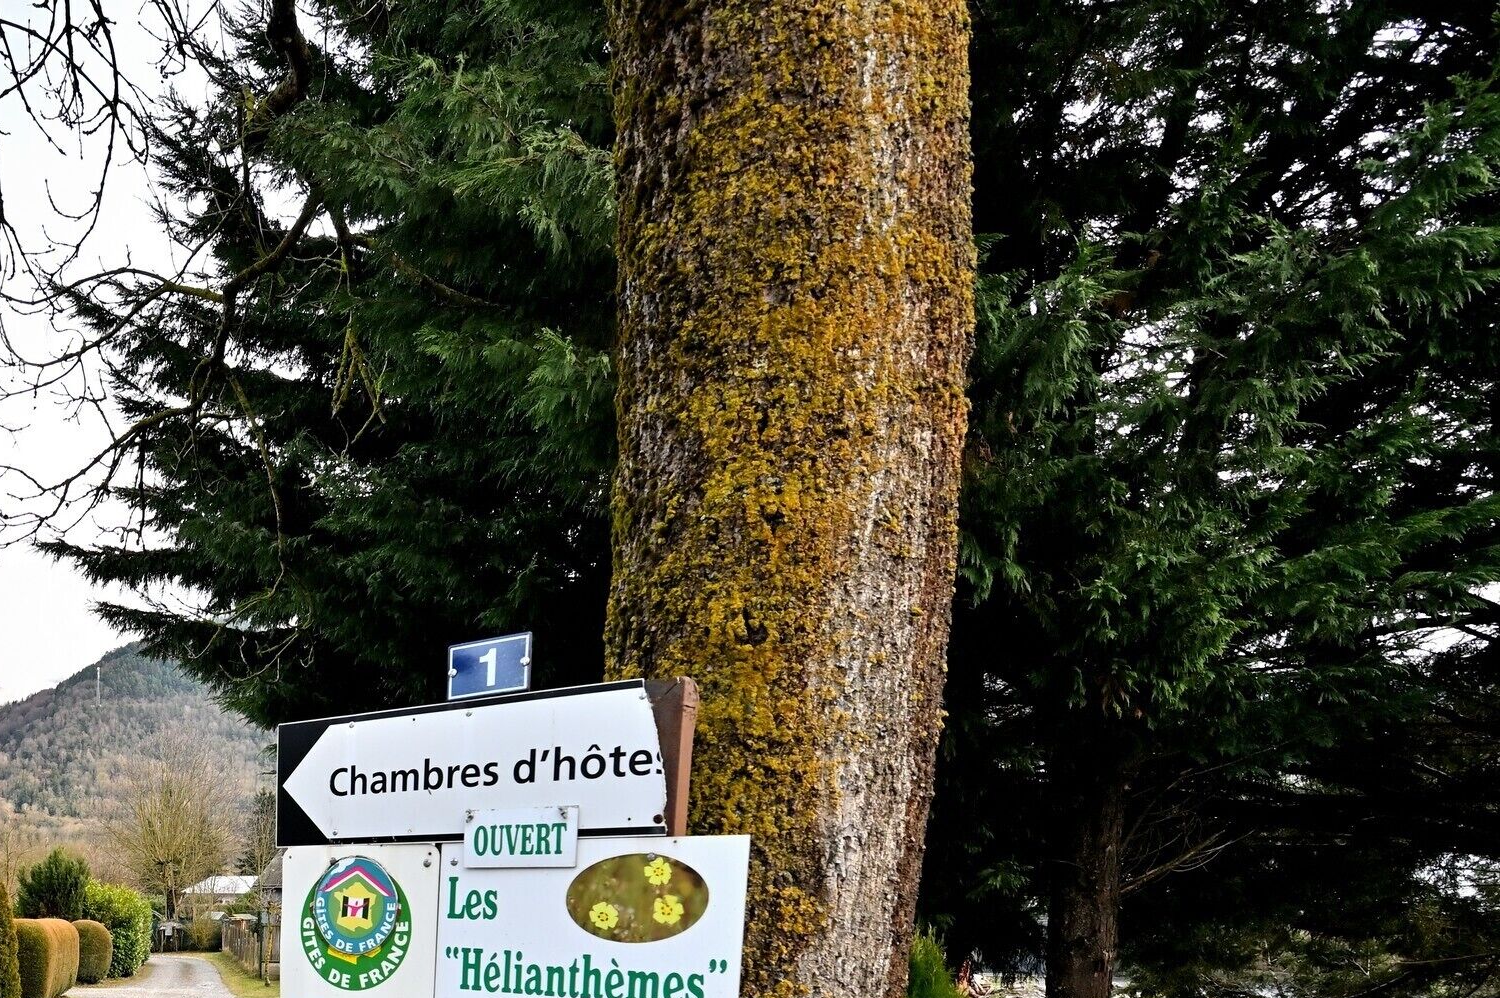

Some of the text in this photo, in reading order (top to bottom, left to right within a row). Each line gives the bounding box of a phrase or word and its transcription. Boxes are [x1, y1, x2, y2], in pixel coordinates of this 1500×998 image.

[479, 648, 497, 687] 1
[328, 758, 499, 797] Chambres
[473, 822, 568, 857] OUVERT
[446, 876, 498, 920] Les
[335, 938, 353, 952] DE
[359, 902, 396, 952] FRANCE
[328, 968, 351, 988] DE
[358, 921, 409, 988] FRANCE
